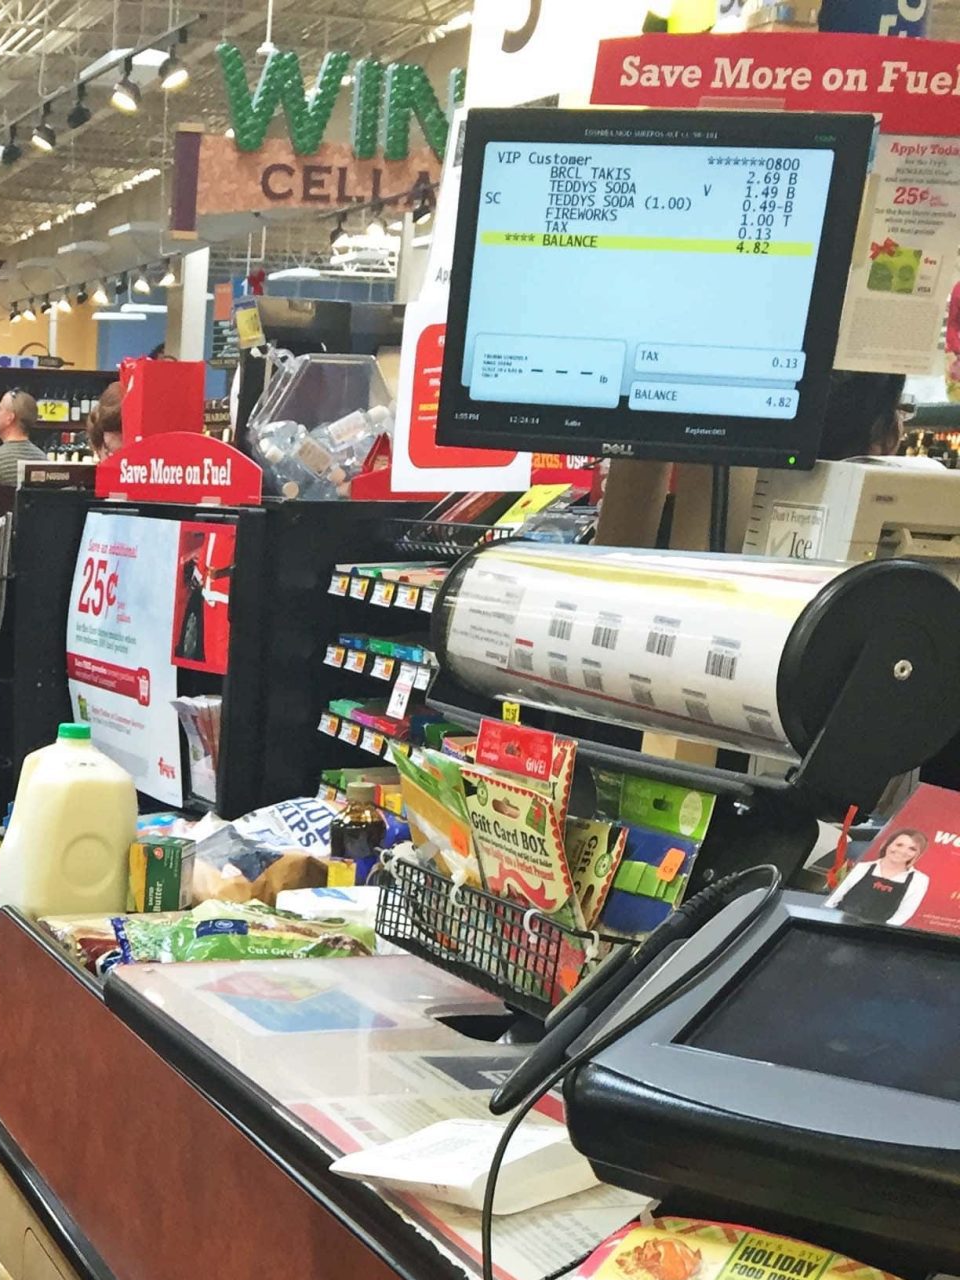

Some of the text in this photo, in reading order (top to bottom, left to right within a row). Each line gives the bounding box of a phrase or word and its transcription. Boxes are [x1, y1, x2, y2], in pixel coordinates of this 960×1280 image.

[620, 55, 960, 95] Save More on Fuel
[497, 151, 521, 164] VIP
[528, 152, 592, 165] Customer
[890, 142, 960, 156] Apply Toda
[549, 166, 798, 186] BRCL TAKIS 2.69 B
[549, 180, 796, 199] TEDDYS SODA V 1.49 B
[485, 192, 501, 204] SC
[548, 193, 596, 207] TEDDYS
[603, 195, 635, 208] SODA
[644, 196, 692, 211] (1.00)
[545, 207, 792, 227] FIREWORKS 1.00 T
[545, 220, 771, 240] TAX 0.13
[542, 235, 598, 248] BALANCE
[736, 241, 770, 254] 4.82
[640, 351, 798, 369] TAX 0.13
[634, 388, 792, 408] BALANCE 4.82
[601, 443, 634, 455] DELL
[120, 458, 232, 486] Save More on Fuel
[788, 531, 812, 559] Ice
[471, 810, 492, 835] Gift
[493, 820, 519, 847] Card
[520, 831, 549, 857] BOX
[152, 881, 163, 911] Butter
[730, 1262, 764, 1280] FOOD
[737, 1246, 819, 1279] HOLIDAY
